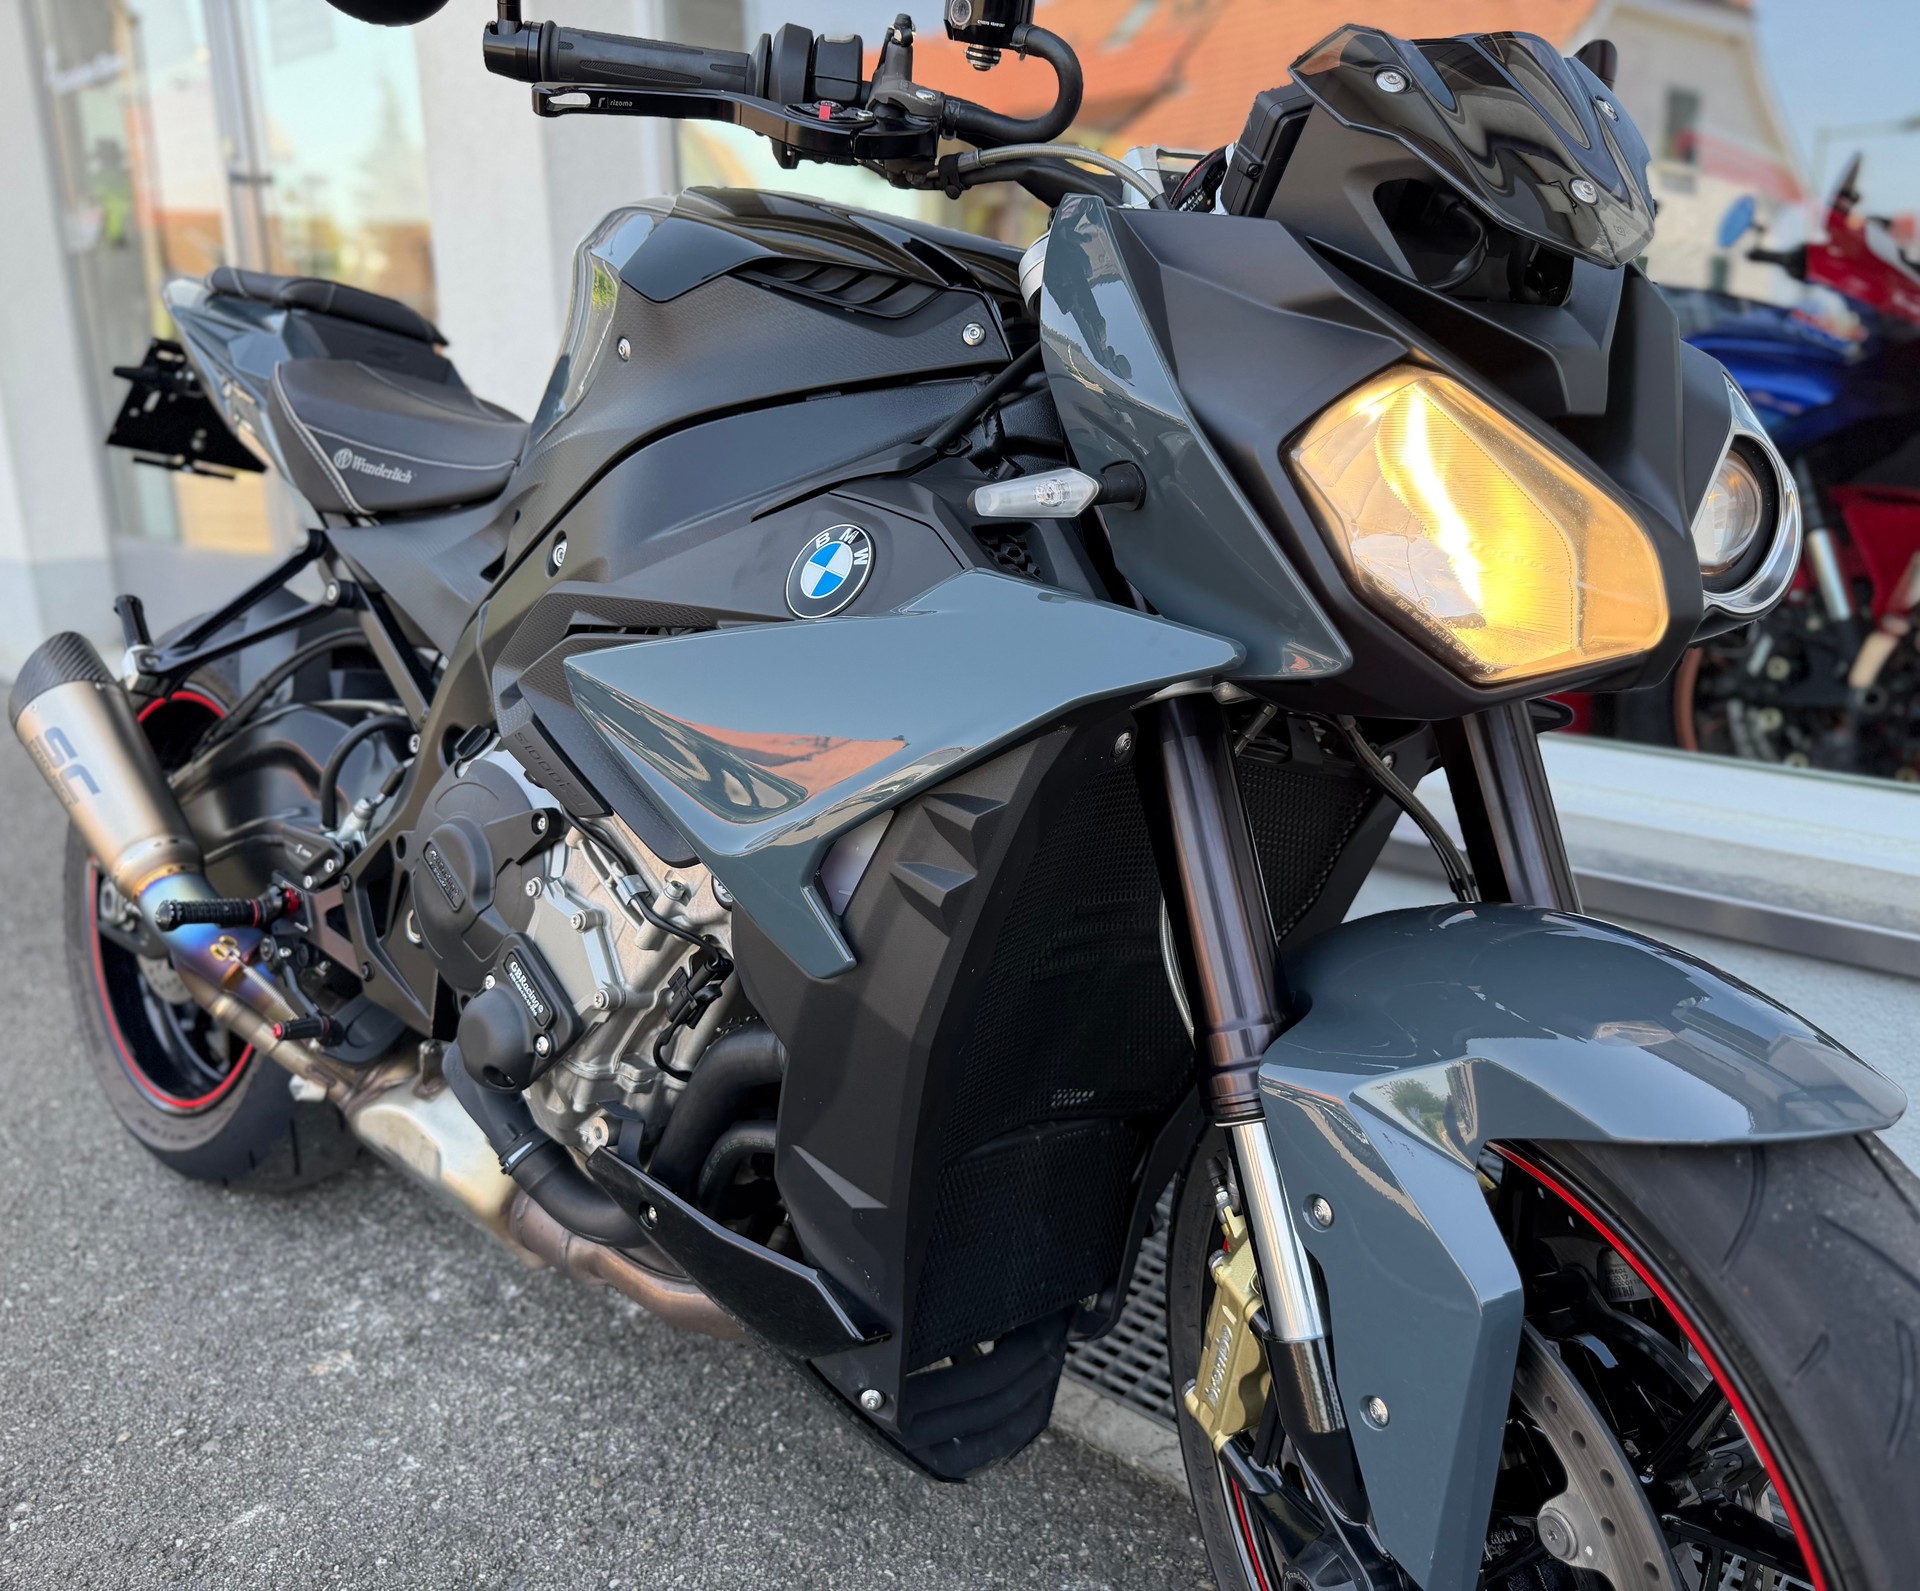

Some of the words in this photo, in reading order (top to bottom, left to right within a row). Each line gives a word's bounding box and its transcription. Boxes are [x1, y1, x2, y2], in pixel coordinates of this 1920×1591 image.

[351, 453, 413, 485] Wunderlich
[815, 527, 870, 566] BMW
[1396, 599, 1411, 612] DOT
[35, 726, 101, 805] SC
[1204, 1324, 1233, 1407] brembo
